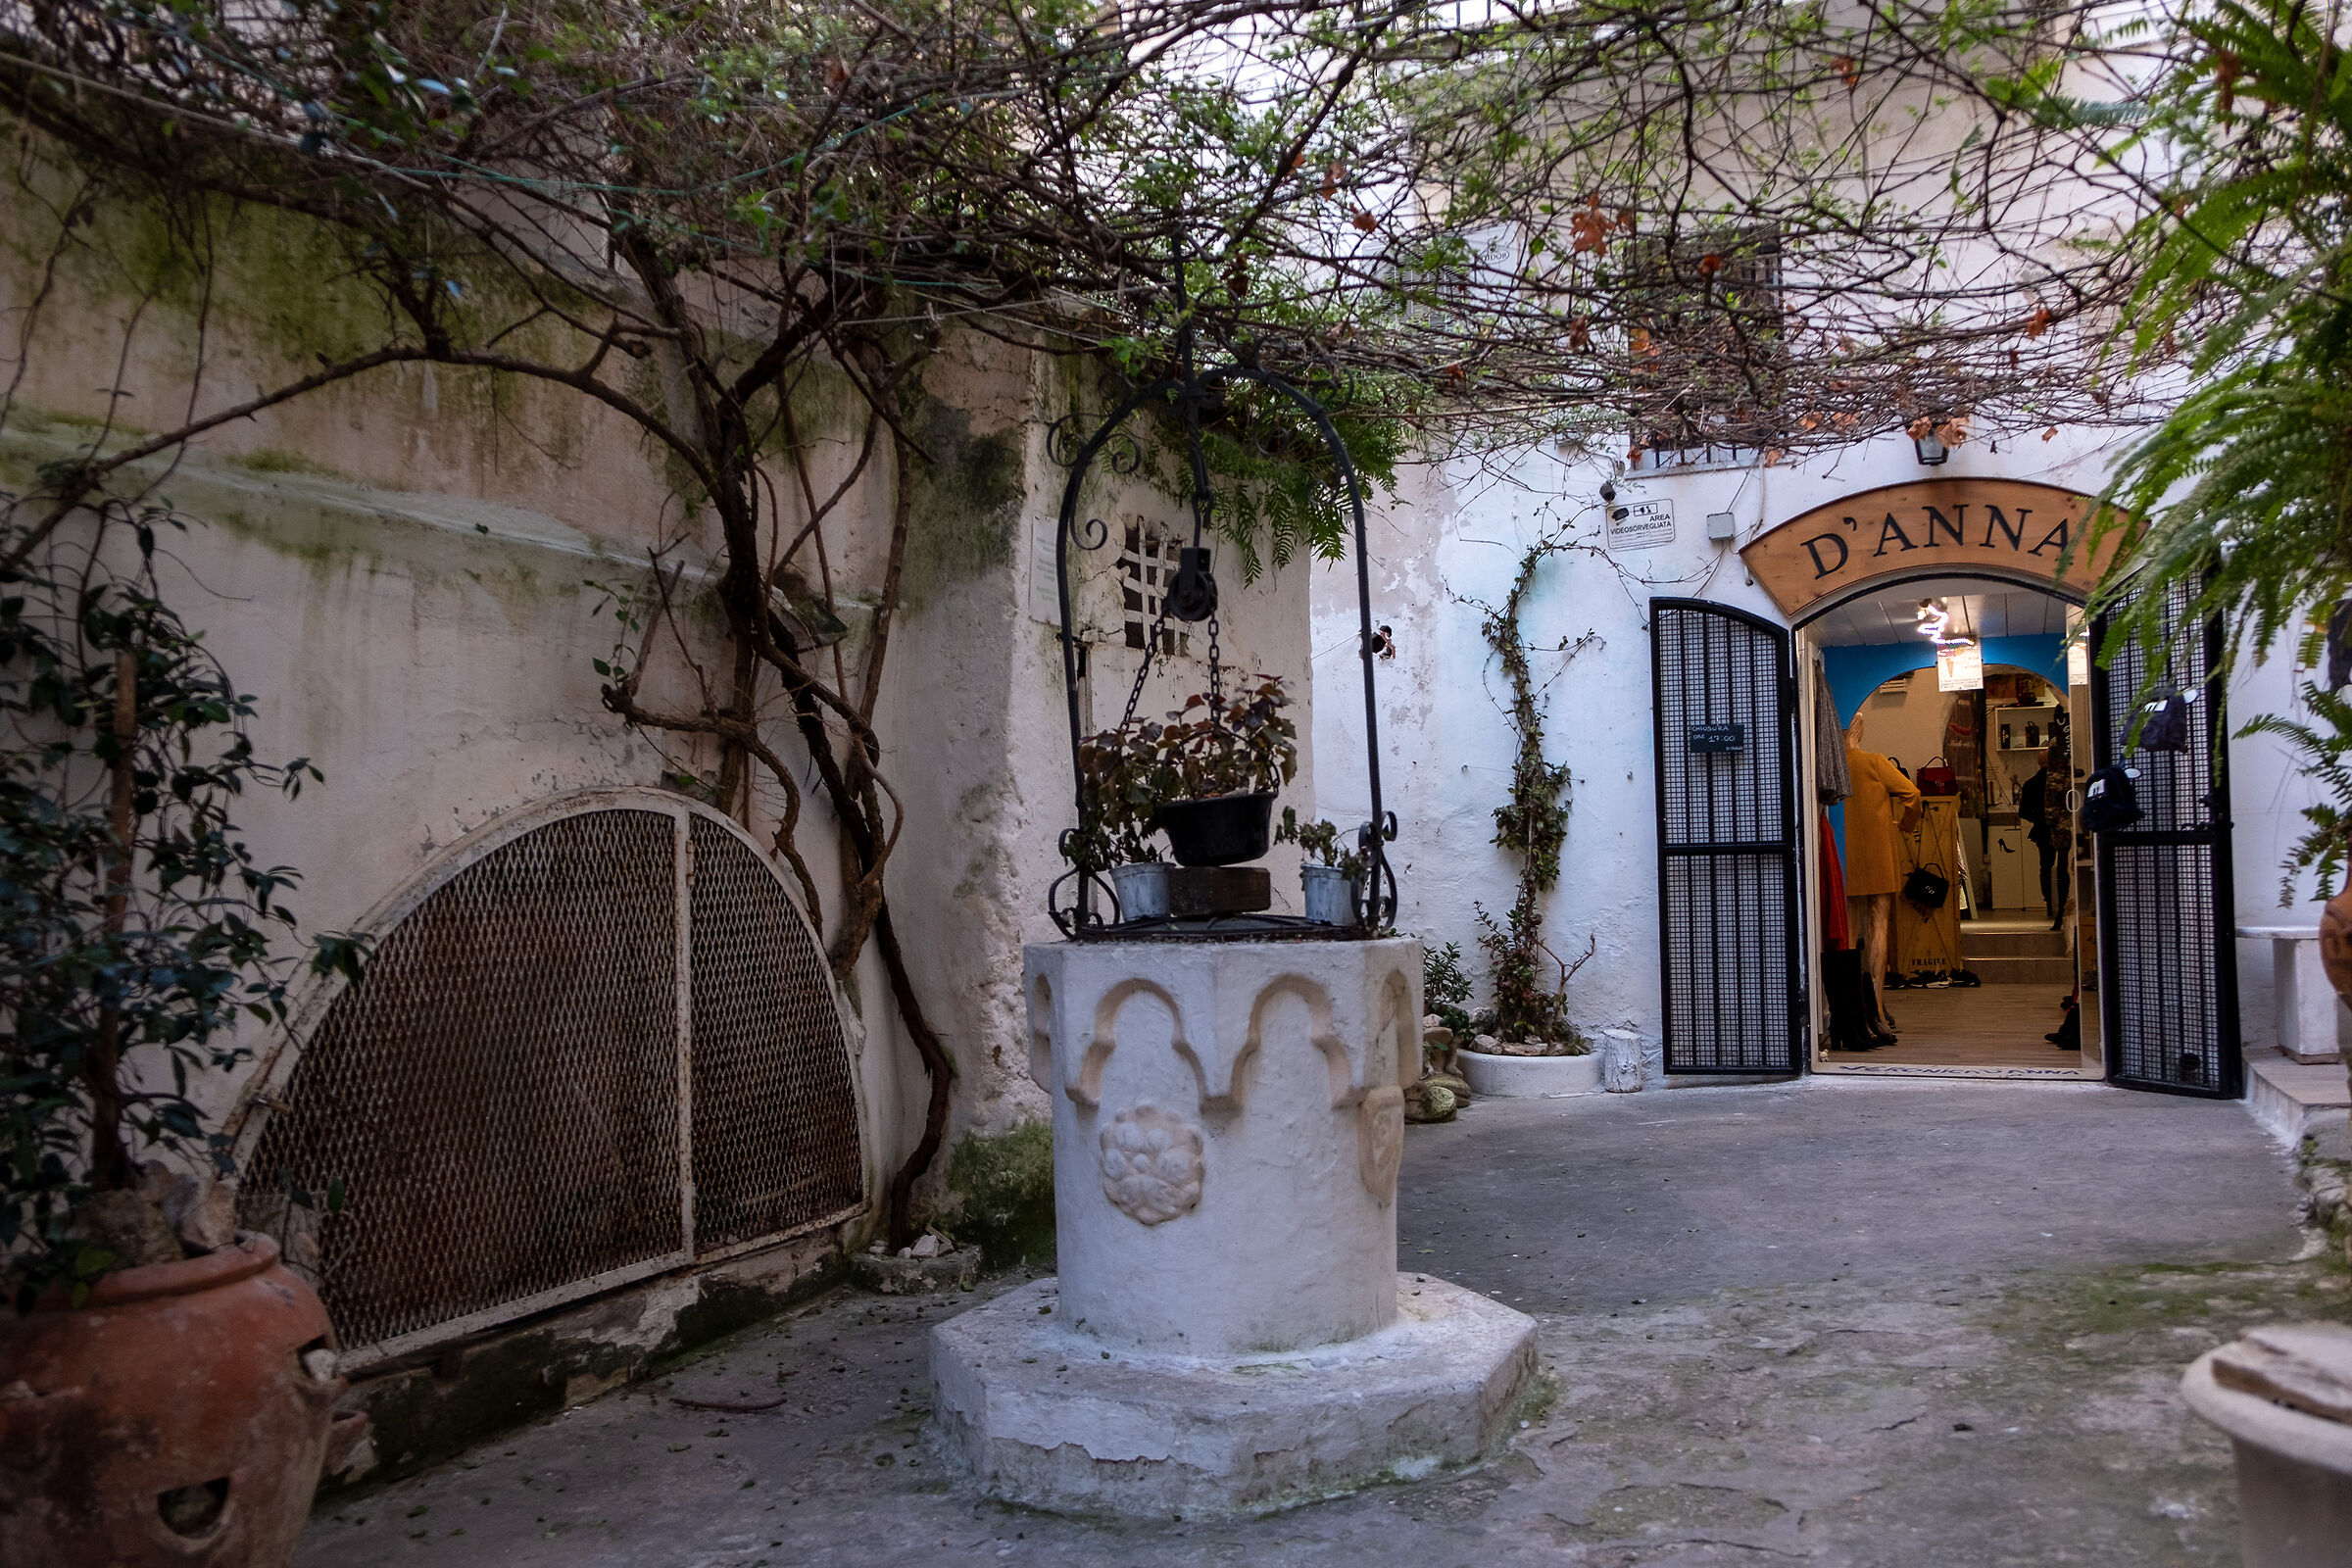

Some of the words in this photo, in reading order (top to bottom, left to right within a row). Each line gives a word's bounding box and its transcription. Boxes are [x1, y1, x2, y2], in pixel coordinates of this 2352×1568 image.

[1610, 521, 1672, 534] VIDEOSORVEGLIATA
[1799, 504, 2073, 580] D'ANNA
[1911, 957, 1947, 966] FRAGILE
[1838, 1065, 1980, 1074] VERONICA
